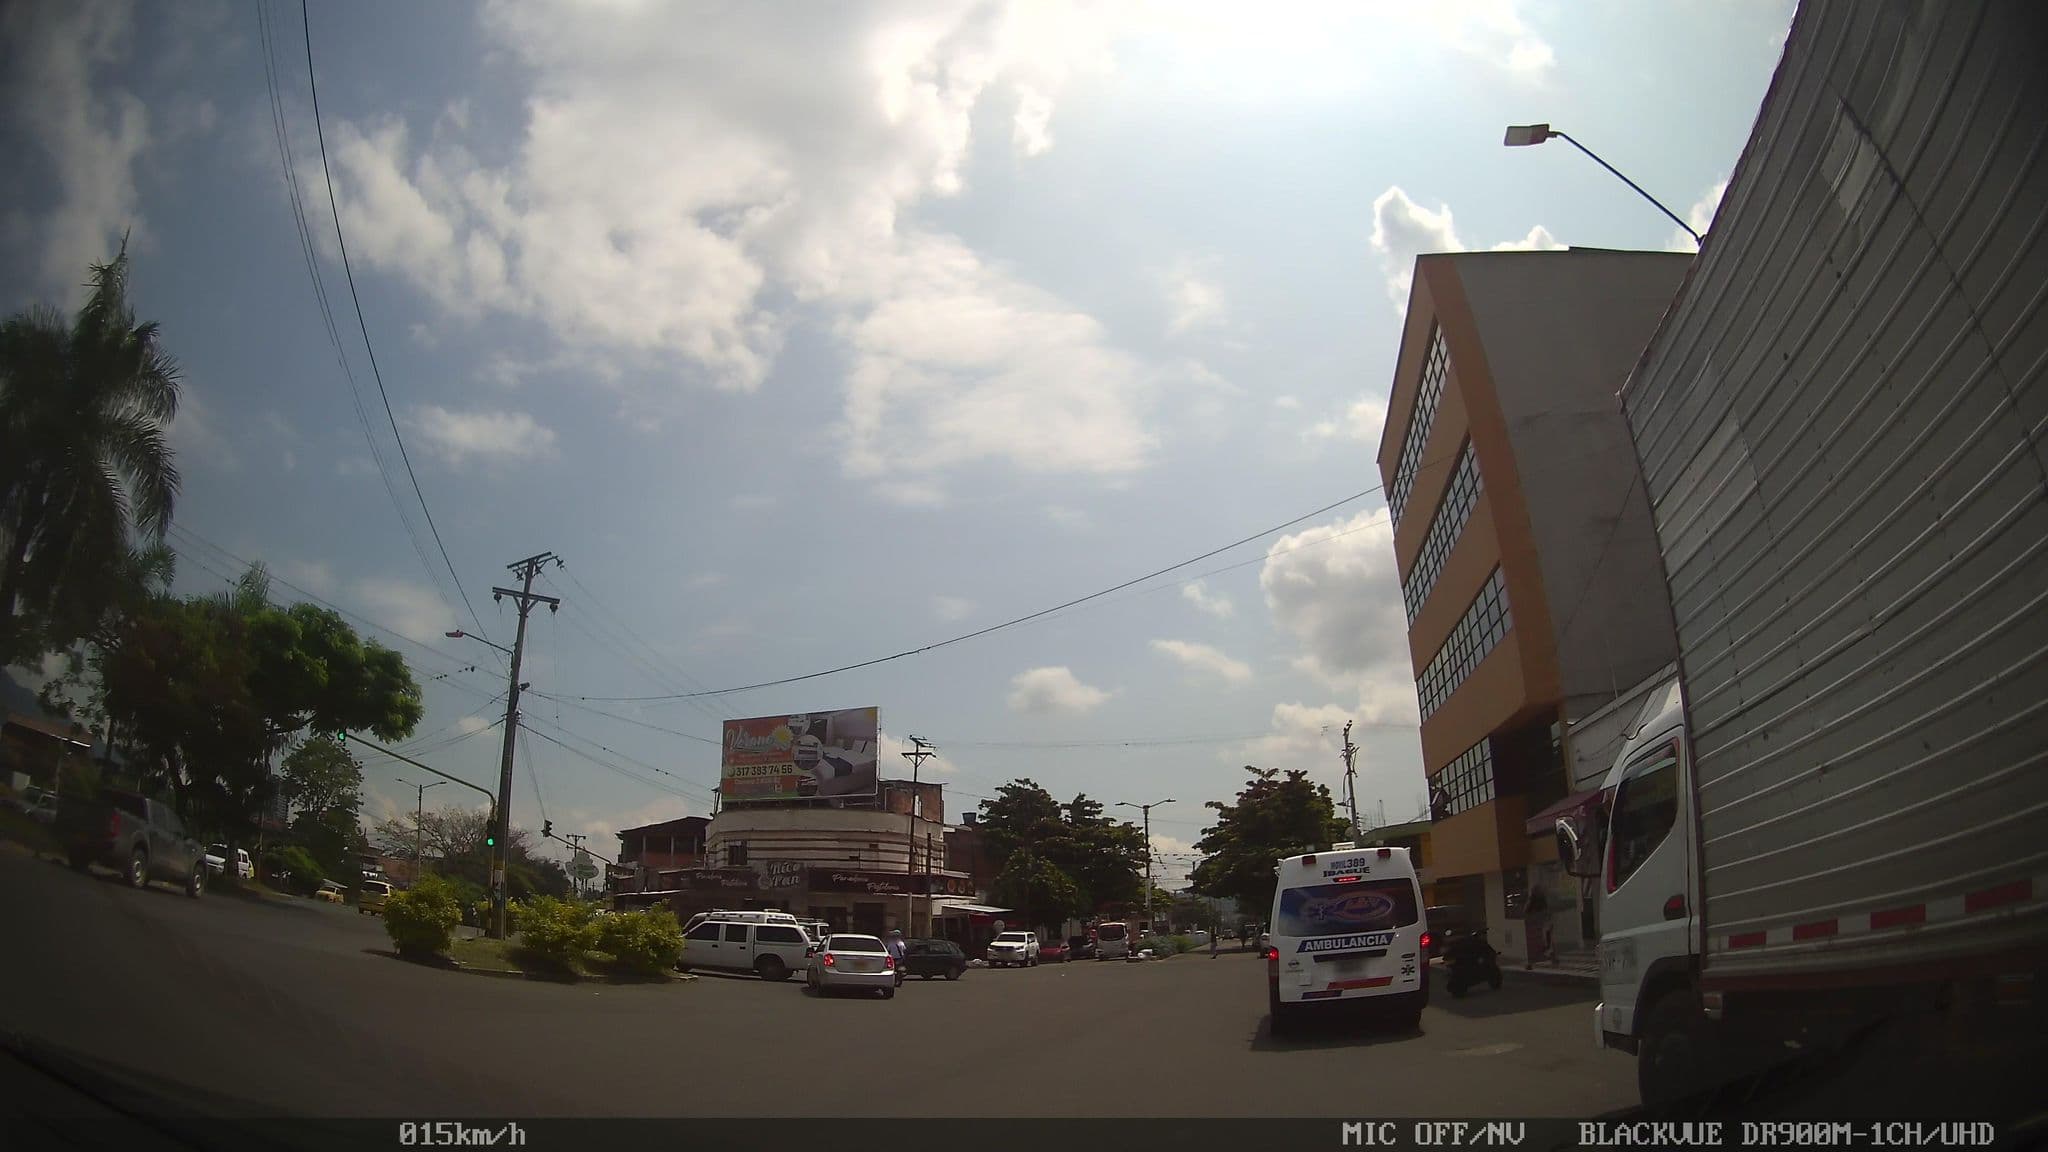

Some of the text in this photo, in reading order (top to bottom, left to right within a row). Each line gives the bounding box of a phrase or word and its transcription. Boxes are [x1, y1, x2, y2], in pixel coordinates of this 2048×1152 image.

[736, 767, 749, 776] 317
[769, 765, 779, 775] 74
[1305, 935, 1387, 952] AMBULANCIA
